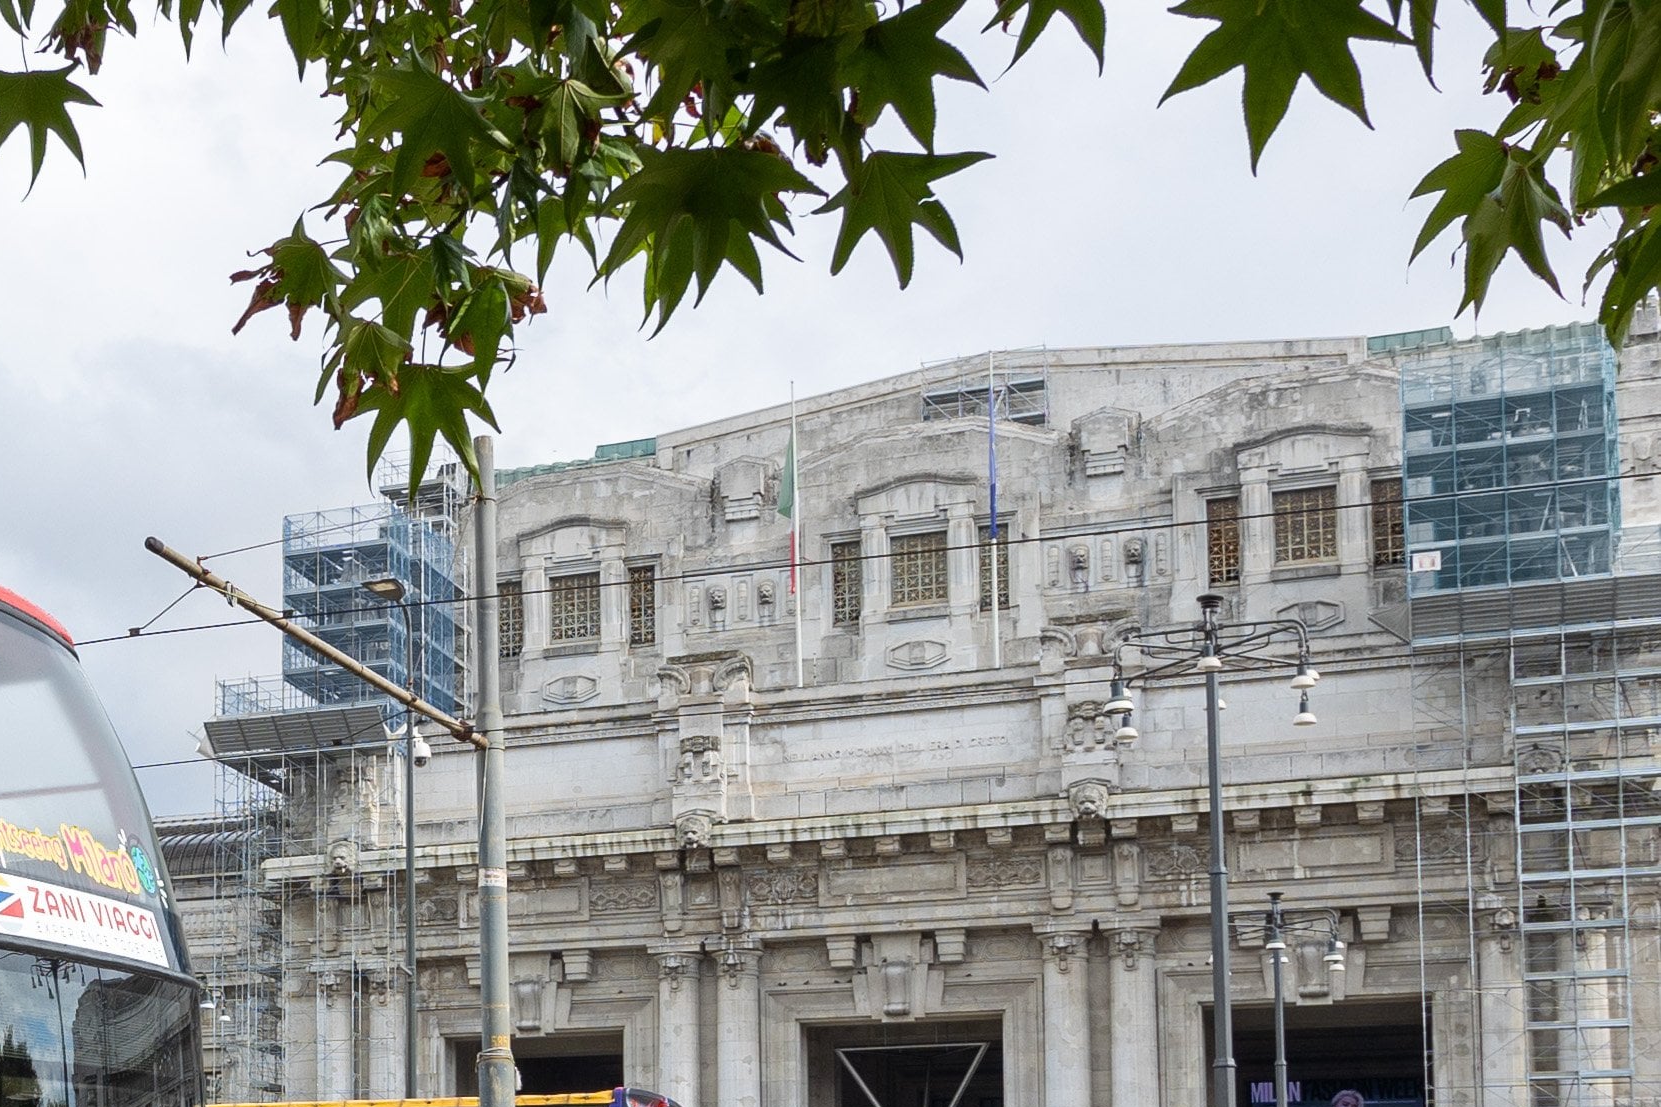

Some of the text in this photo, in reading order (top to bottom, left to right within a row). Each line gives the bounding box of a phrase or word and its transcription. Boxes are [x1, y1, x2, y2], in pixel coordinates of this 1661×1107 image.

[59, 823, 139, 894] Milano
[27, 886, 85, 922] ZANI
[89, 900, 159, 942] VIAGGI
[1251, 1081, 1301, 1103] MILN
